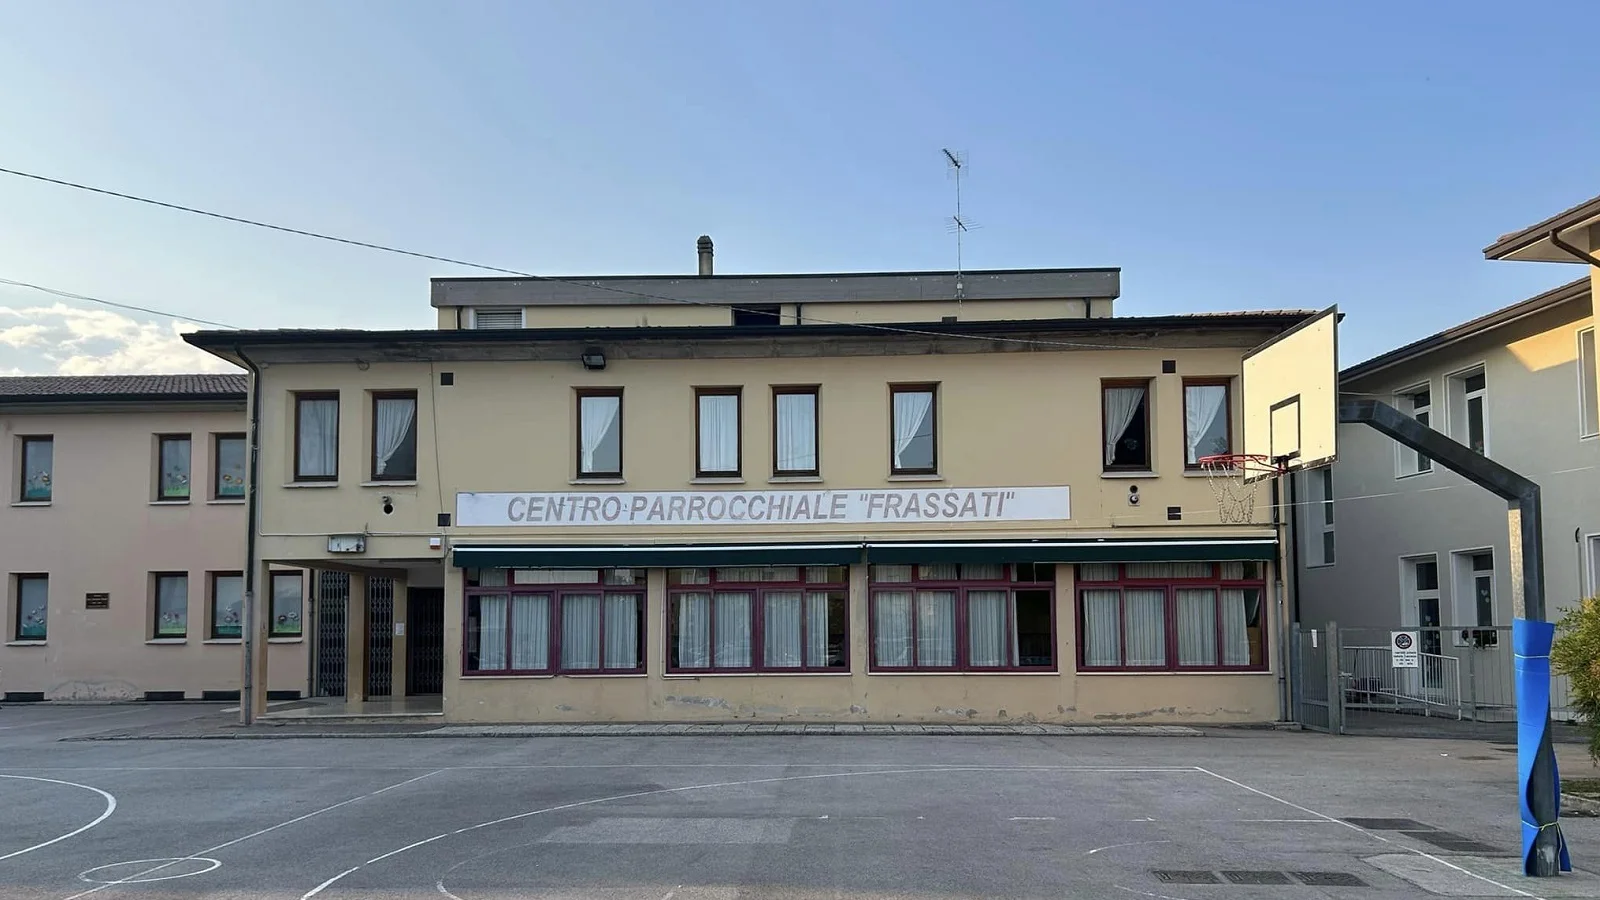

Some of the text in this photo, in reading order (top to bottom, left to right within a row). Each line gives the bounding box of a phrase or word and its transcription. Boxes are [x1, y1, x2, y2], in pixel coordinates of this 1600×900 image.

[507, 491, 1015, 522] CENTRO PARROCCHIALE "FRASSATI"
